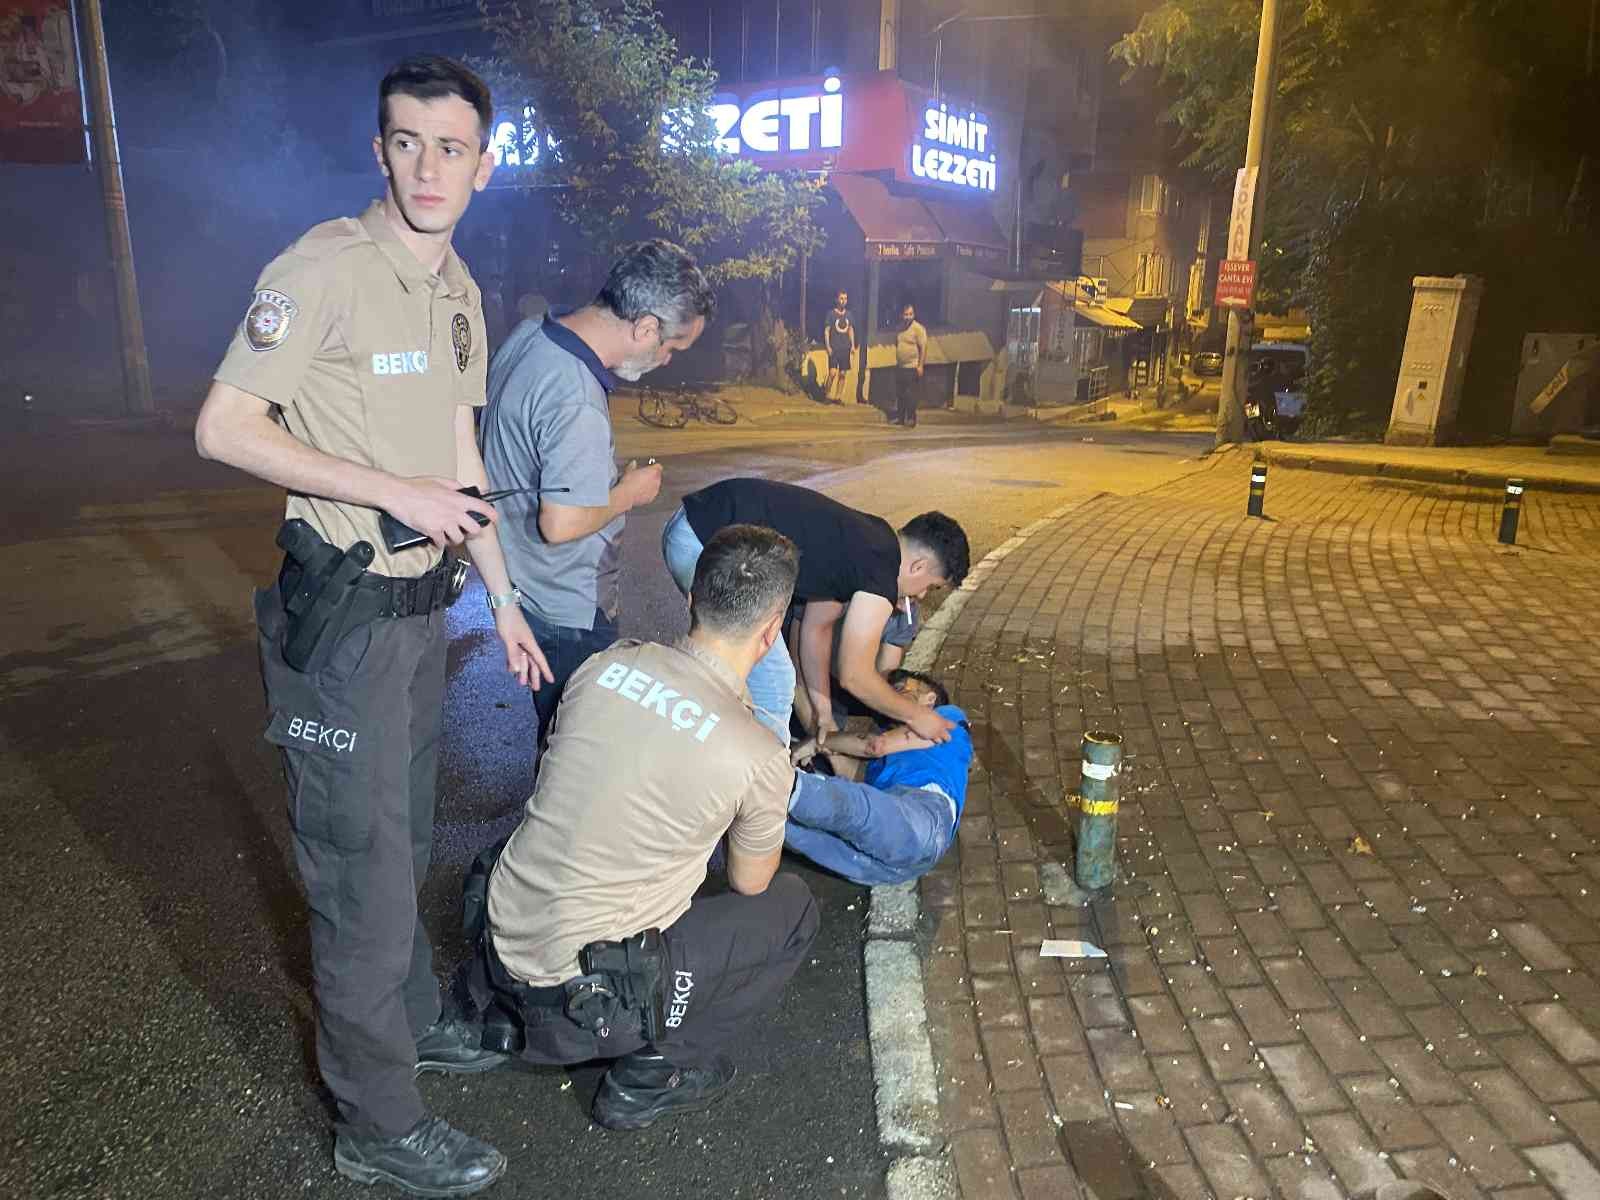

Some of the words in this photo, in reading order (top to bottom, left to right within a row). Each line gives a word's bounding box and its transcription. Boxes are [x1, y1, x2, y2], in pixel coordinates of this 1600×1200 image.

[923, 102, 989, 153] SİMİT
[911, 143, 997, 192] LEZZETİ
[596, 662, 720, 743] BEKÇİ
